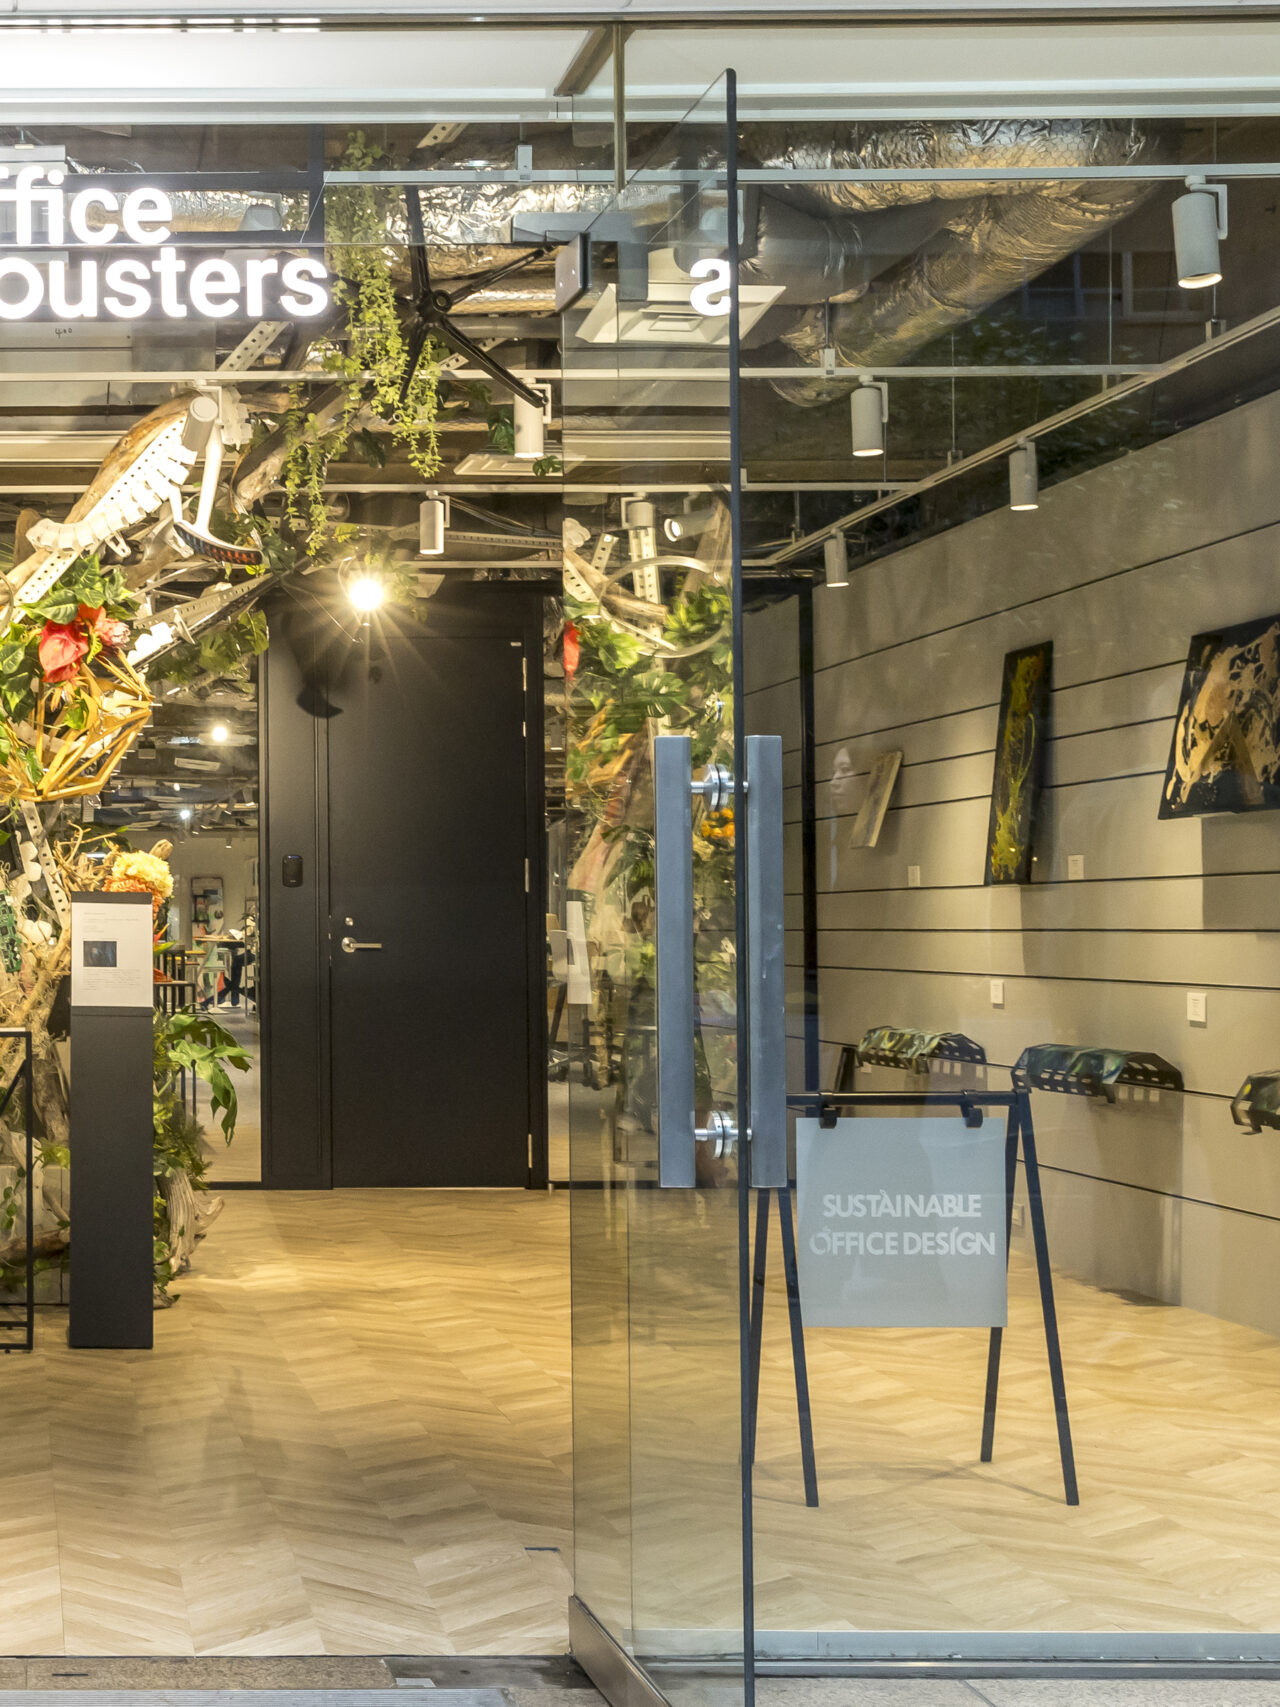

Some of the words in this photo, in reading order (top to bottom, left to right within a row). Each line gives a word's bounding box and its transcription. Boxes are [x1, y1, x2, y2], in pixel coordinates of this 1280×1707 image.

[823, 1189, 982, 1218] SUSTAINABLE
[809, 1226, 899, 1256] OFFICE
[903, 1227, 997, 1256] DESIGN
